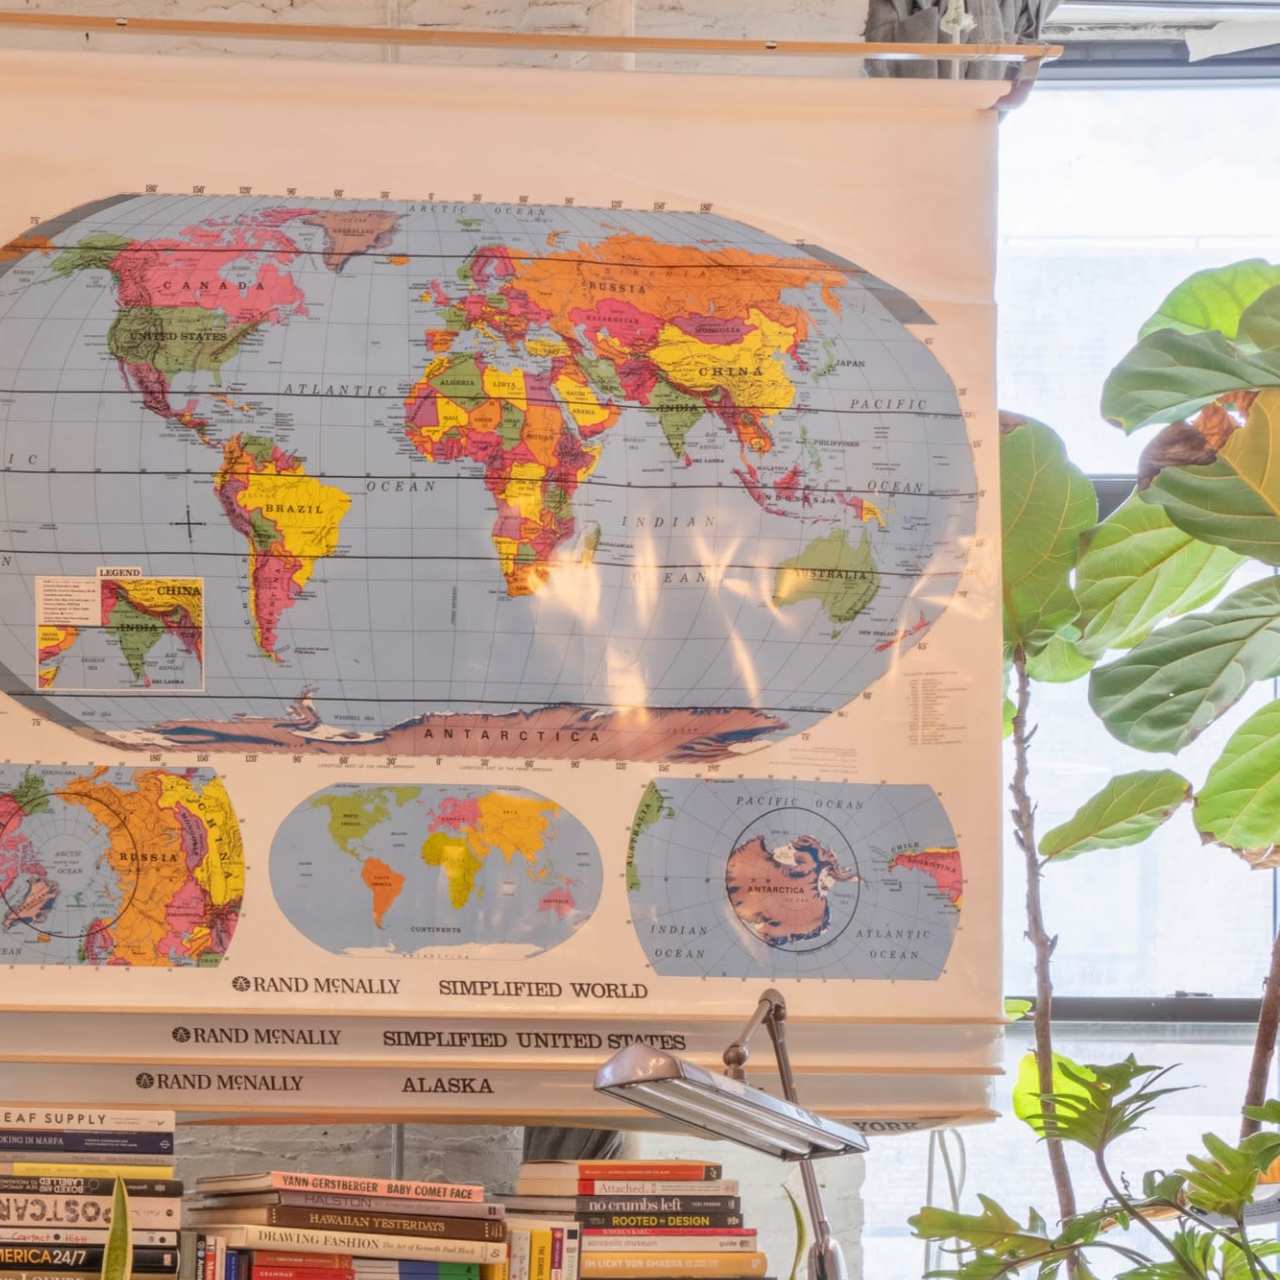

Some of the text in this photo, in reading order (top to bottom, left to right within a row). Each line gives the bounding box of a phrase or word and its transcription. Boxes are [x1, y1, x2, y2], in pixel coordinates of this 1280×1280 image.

[409, 205, 546, 216] ARCTIC OCEAN
[162, 281, 265, 290] CANADA
[590, 283, 646, 294] RUSSIA
[129, 332, 228, 342] UNITED STATES
[836, 359, 866, 368] JAPAN
[699, 366, 764, 378] CHINA
[284, 383, 388, 397] ATLANTIC
[660, 403, 699, 413] INDIA
[850, 399, 928, 410] PACIFIC
[366, 480, 437, 492] OCEAN
[867, 480, 923, 493] OCEAN
[265, 503, 324, 514] BRAZIL
[622, 516, 716, 528] INDIAN
[99, 568, 141, 577] LEGEND
[157, 585, 202, 597] CHINA
[120, 623, 158, 633] INDIA
[424, 728, 600, 742] ANTARCTICA
[736, 795, 865, 810] PACIFIC OCEAN
[198, 802, 233, 880] CHINA
[120, 852, 178, 862] RUSSIA
[747, 885, 805, 895] ANTARCTICA
[650, 924, 709, 936] INDIAN
[856, 927, 931, 939] ATLANTIC
[654, 949, 706, 959] OCEAN
[869, 949, 920, 960] OCEAN
[253, 976, 649, 999] RAND McNALLY SIMPLIFIED WORLD
[193, 1027, 687, 1051] RAND McNALLY SIMPLIFIED UNITED STATES
[157, 1073, 494, 1094] RAND McNALLY ALASKA
[44, 1112, 107, 1125] SUPPLY
[282, 1175, 473, 1200] YANN GERSTBERGER BABY COMET FACE
[304, 1194, 373, 1208] HALSTON
[589, 1198, 681, 1212] no crumbs left
[309, 1213, 446, 1233] HAWAIIAN YESTERDAYS
[612, 1216, 710, 1227] ROOTED DESIGN
[258, 1230, 320, 1245] DRAWING
[323, 1234, 380, 1250] FASHION
